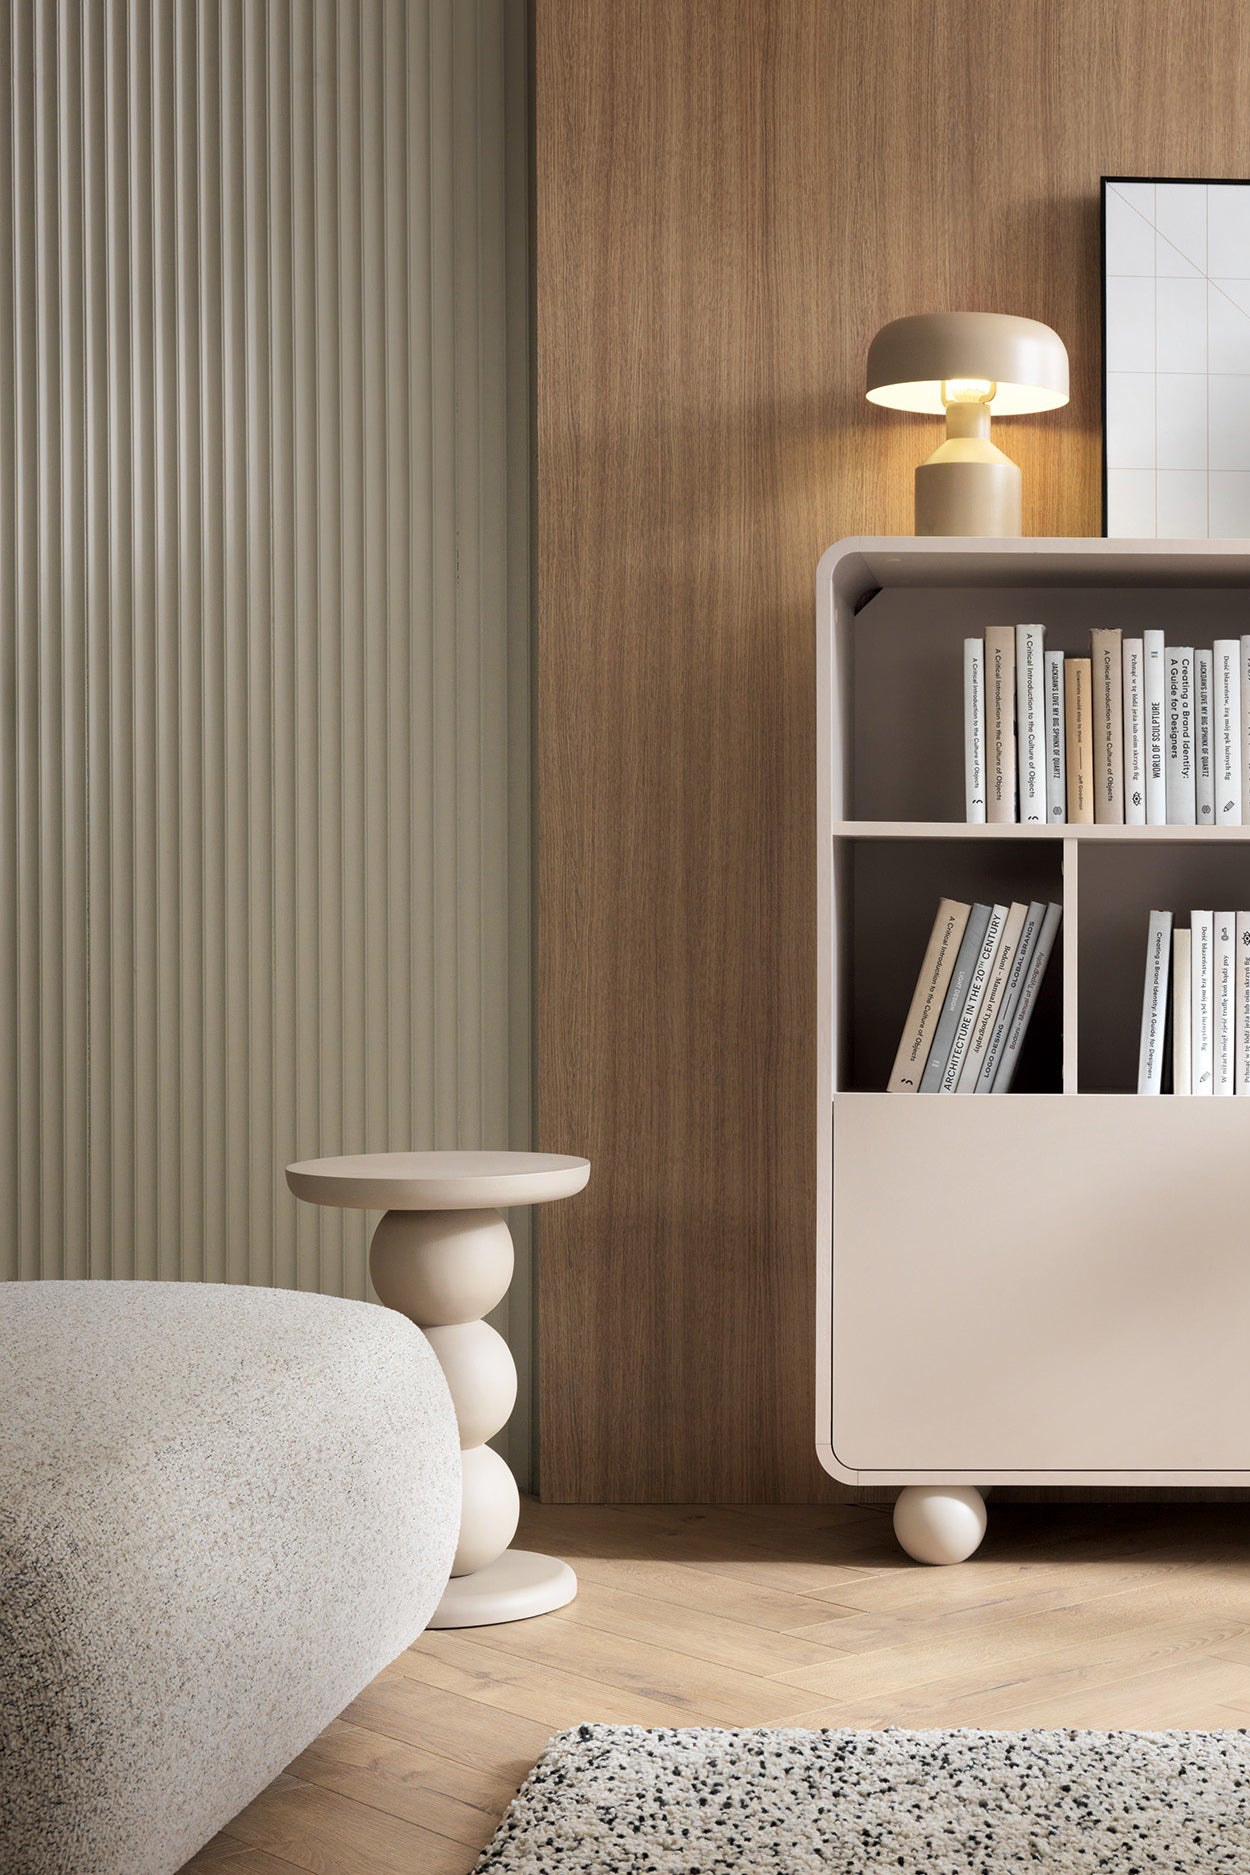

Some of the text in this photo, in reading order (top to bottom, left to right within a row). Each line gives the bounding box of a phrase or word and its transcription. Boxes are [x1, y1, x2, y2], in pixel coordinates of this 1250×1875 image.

[1026, 640, 1034, 667] Critical
[994, 655, 1002, 680] Critical
[994, 680, 1002, 721] Introduction
[1026, 667, 1034, 711] Introduction
[1027, 712, 1034, 720] to
[1051, 661, 1061, 779] JACKDAWS LOVE MY BIG SPHINX OF QUARTZ
[1169, 658, 1179, 759] A Guide for Designers
[1179, 658, 1191, 779] Creating a Brand Identity:
[995, 721, 1001, 729] to
[1027, 721, 1035, 733] the
[1223, 718, 1231, 732] mój
[995, 741, 1003, 767] Culture
[1027, 733, 1036, 761] Culture
[1151, 702, 1161, 779] WORLD OF SCULPTURE
[995, 767, 1003, 775] of
[1028, 761, 1036, 770] of
[1224, 771, 1232, 781] fig
[993, 775, 1003, 801] Objects
[1027, 770, 1036, 798] Objects
[981, 913, 1001, 960] CENTURY
[1153, 931, 1163, 960] Creating
[1153, 966, 1161, 985] Brand
[968, 983, 982, 1002] THE
[973, 945, 1011, 1054] Bodoni Manual of Typography
[983, 921, 1035, 1079] LOGO DESING GLOBAL BRANDS
[1150, 985, 1159, 1012] Identity:
[965, 1004, 975, 1016] IN
[1149, 1018, 1157, 1038] Guide
[943, 1016, 972, 1091] ARCHITECTURE
[1146, 1048, 1155, 1080] Designers
